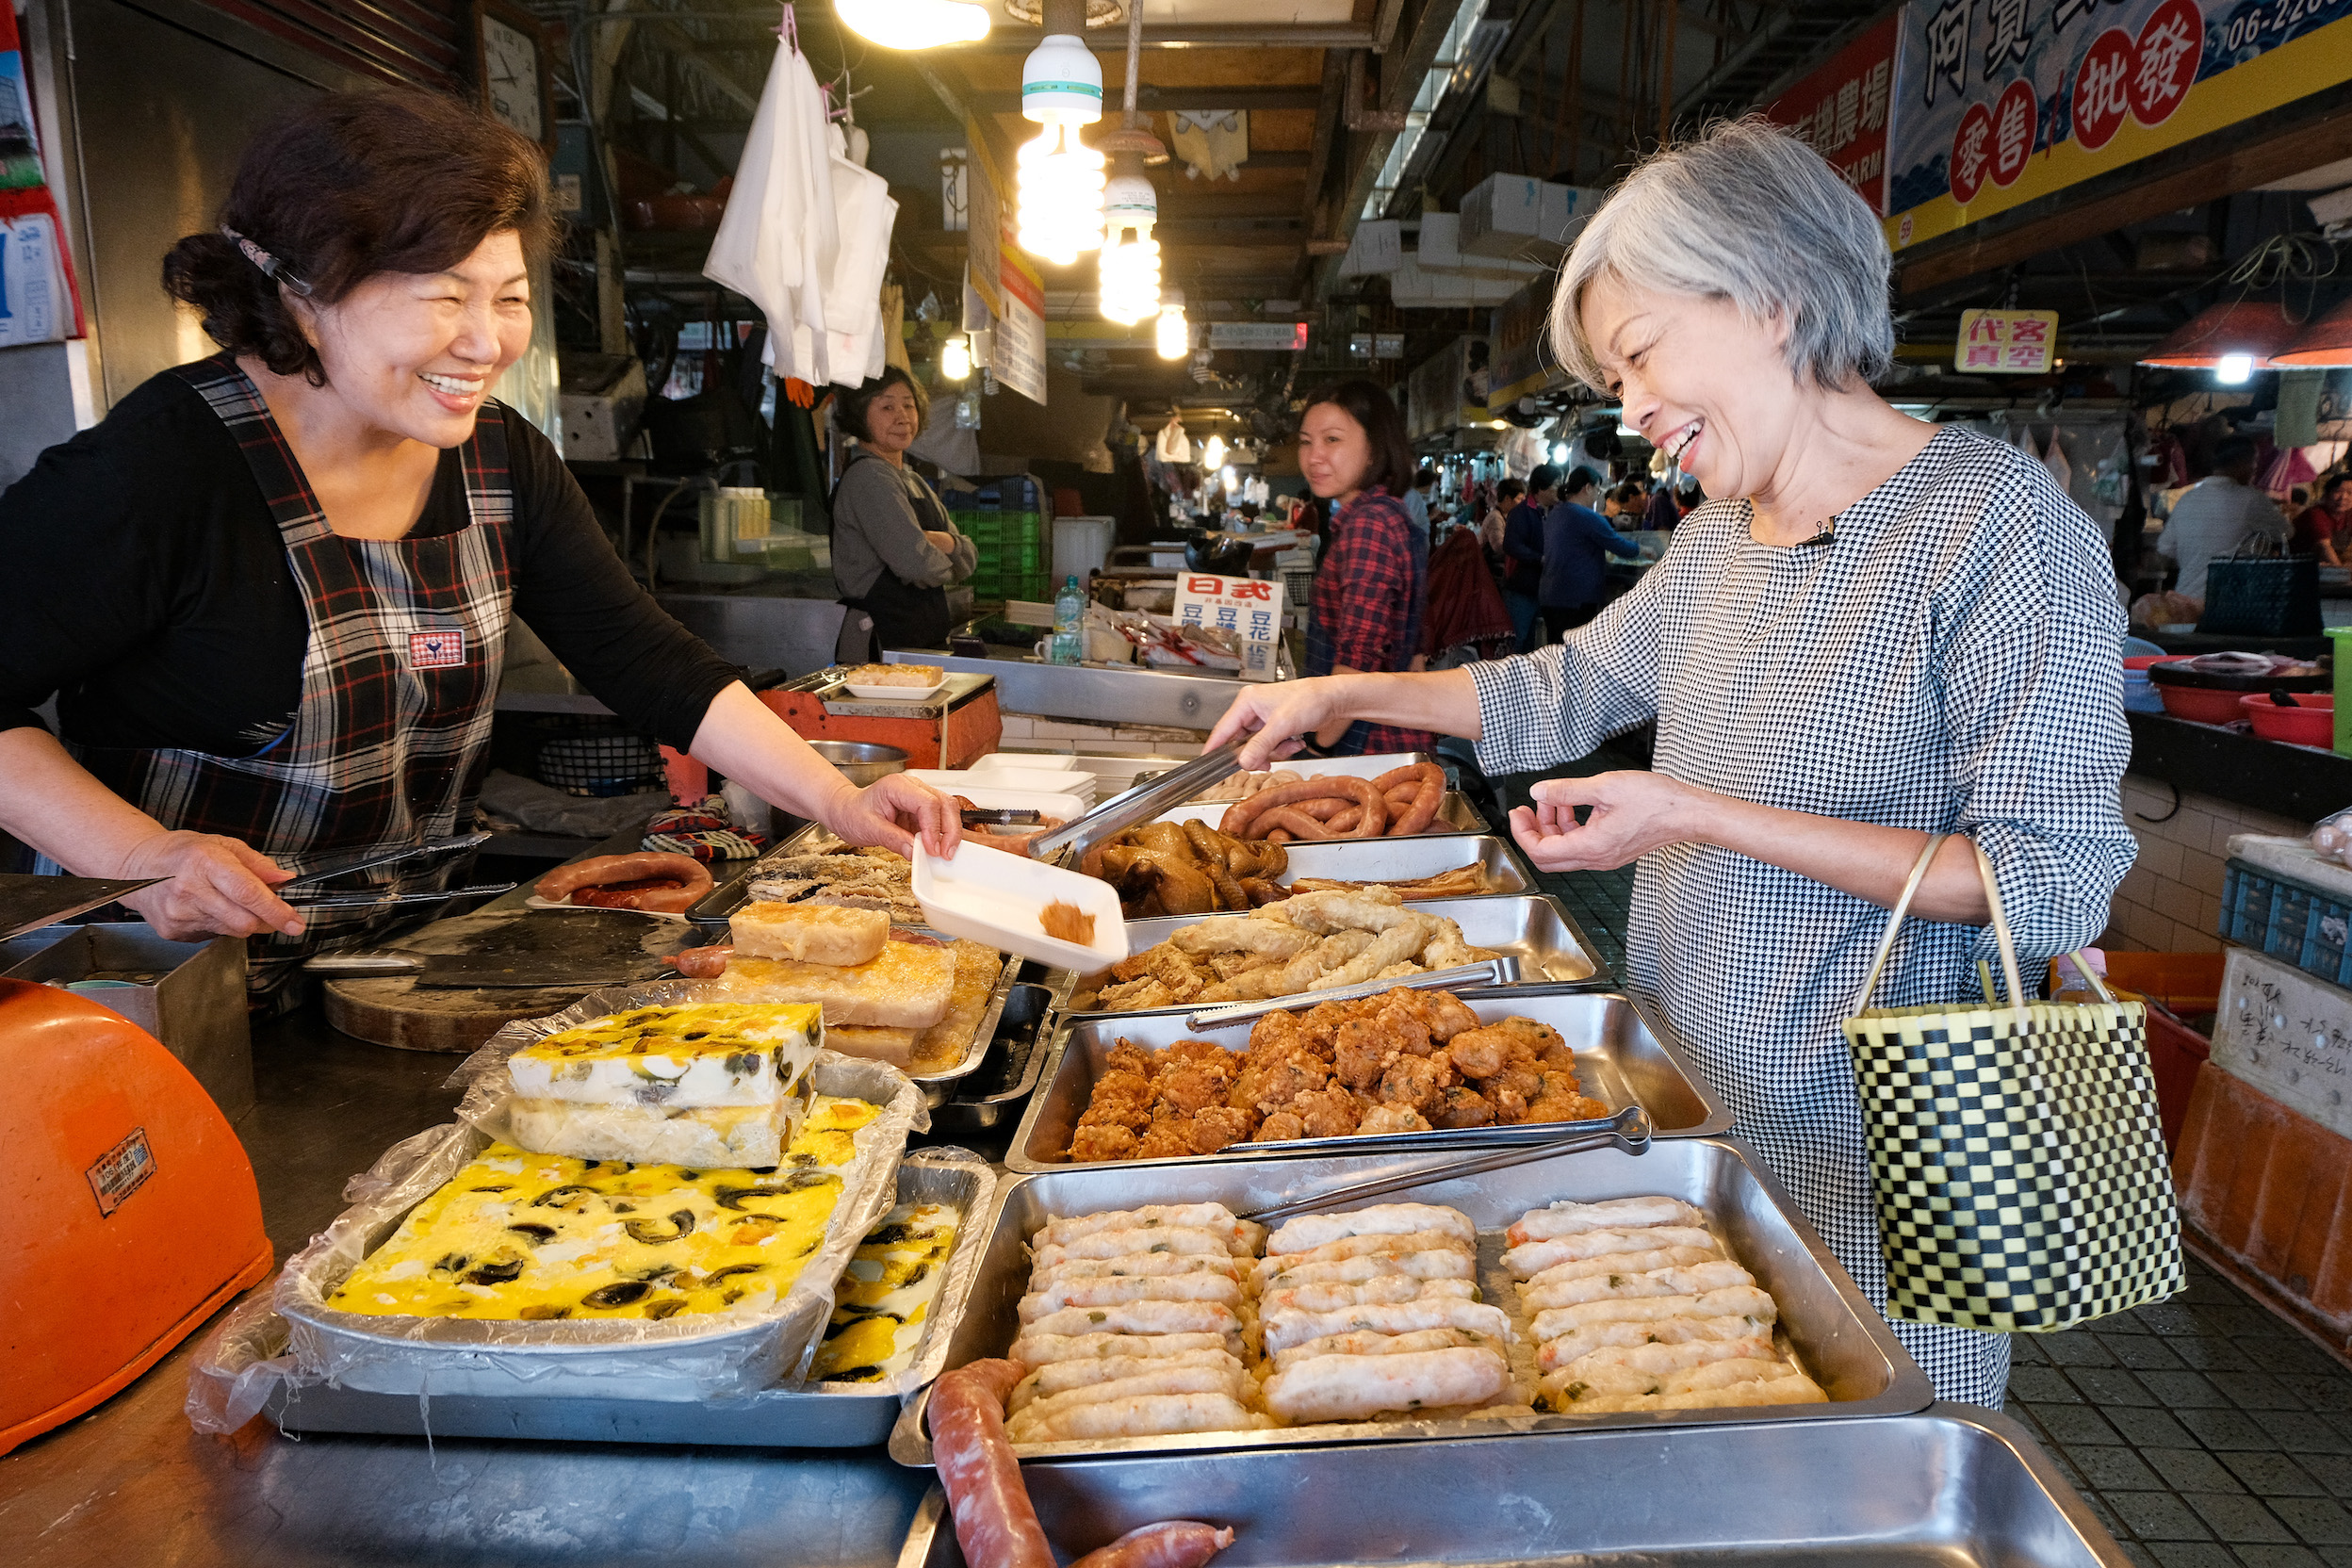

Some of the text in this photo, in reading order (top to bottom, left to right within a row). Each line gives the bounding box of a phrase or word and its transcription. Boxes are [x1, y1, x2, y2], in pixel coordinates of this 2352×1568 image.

[2228, 0, 2339, 51] 06-22
[1955, 10, 2195, 190] 零售 批發
[1968, 318, 2049, 342] 代客
[1965, 345, 2045, 368] 真空
[1187, 577, 1272, 601] 日式
[1250, 611, 1271, 641] 豆花
